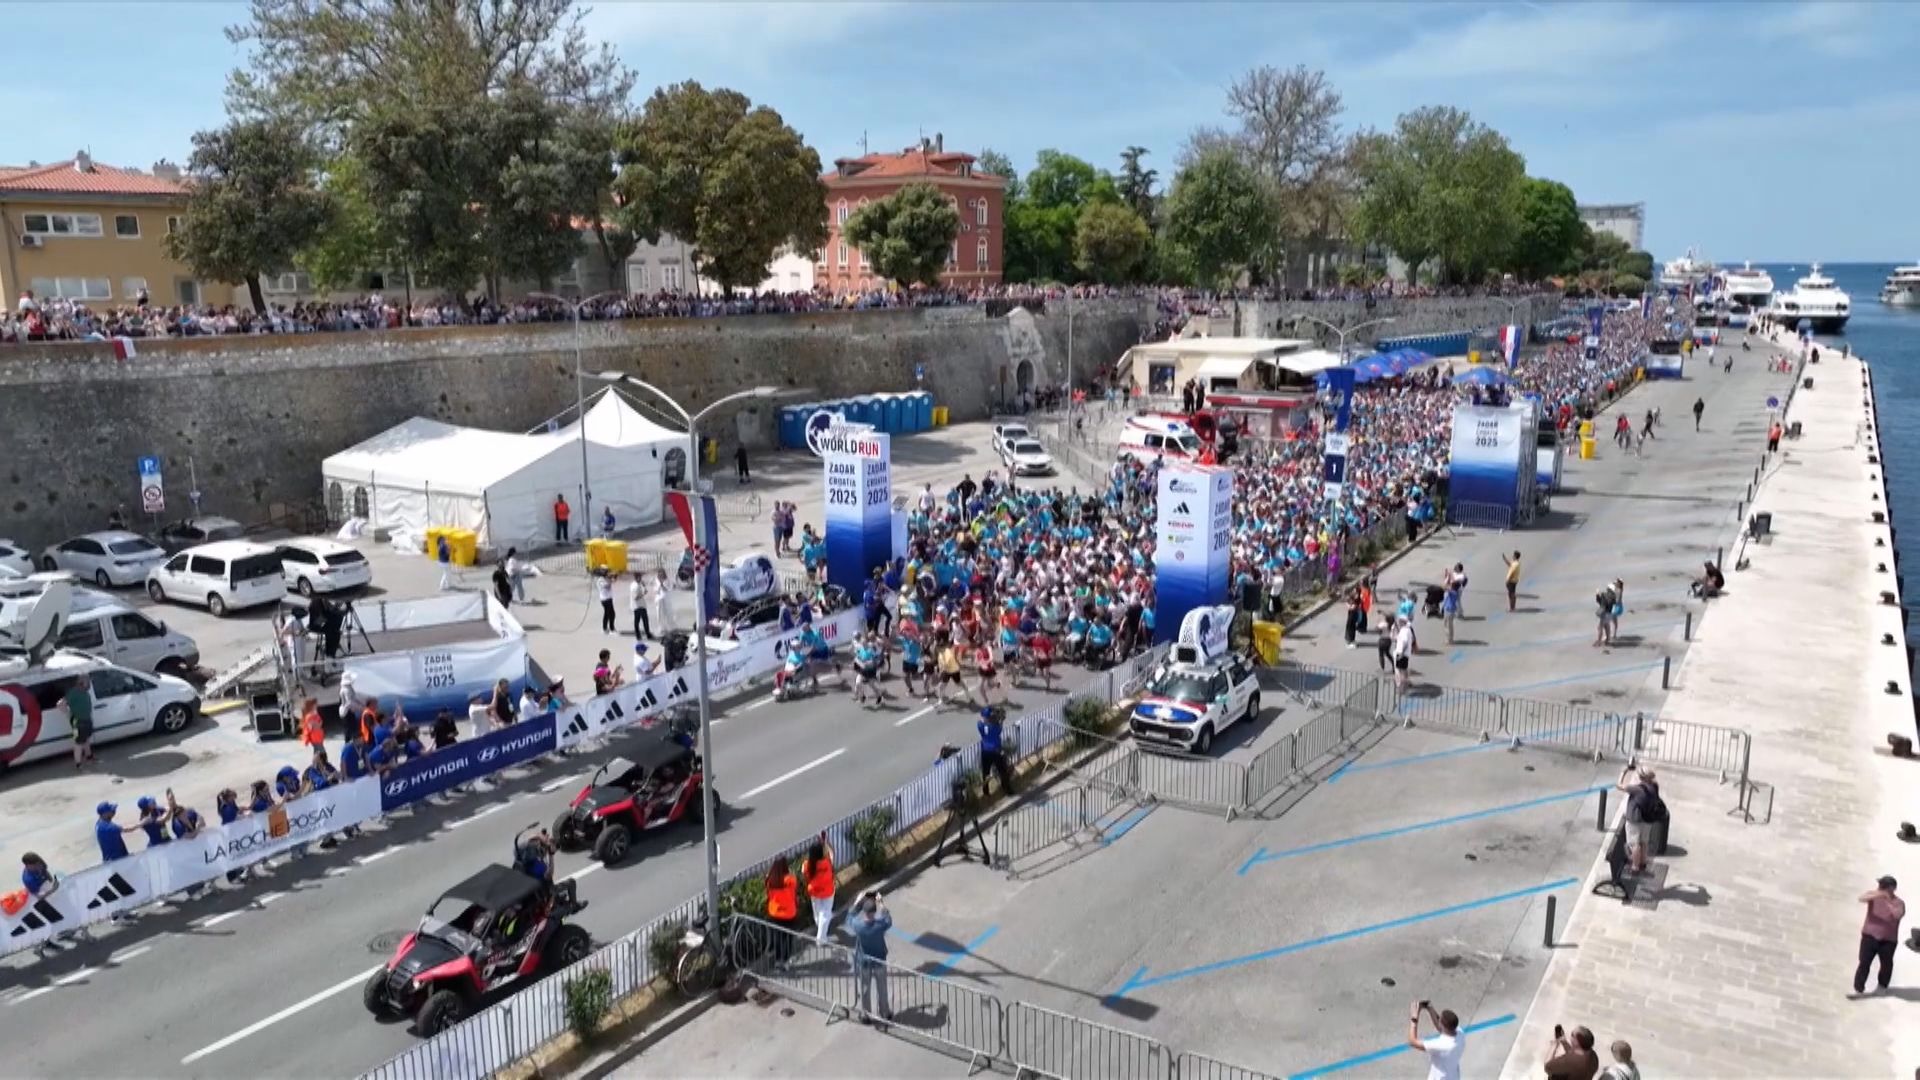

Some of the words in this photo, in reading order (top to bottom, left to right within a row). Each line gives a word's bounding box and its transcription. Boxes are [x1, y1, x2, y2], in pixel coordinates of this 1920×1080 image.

[1475, 437, 1498, 447] 2025
[829, 463, 855, 475] ZADAR
[867, 461, 886, 475] ZADAR
[829, 476, 856, 487] CROATIA
[829, 488, 857, 506] 2025
[867, 487, 888, 505] 2025
[1213, 529, 1230, 551] 2025
[424, 653, 452, 665] ZADAR
[426, 673, 455, 689] 2025
[502, 727, 553, 754] HYUNDAI
[410, 757, 468, 786] HYUNDAI
[204, 844, 227, 864] LA
